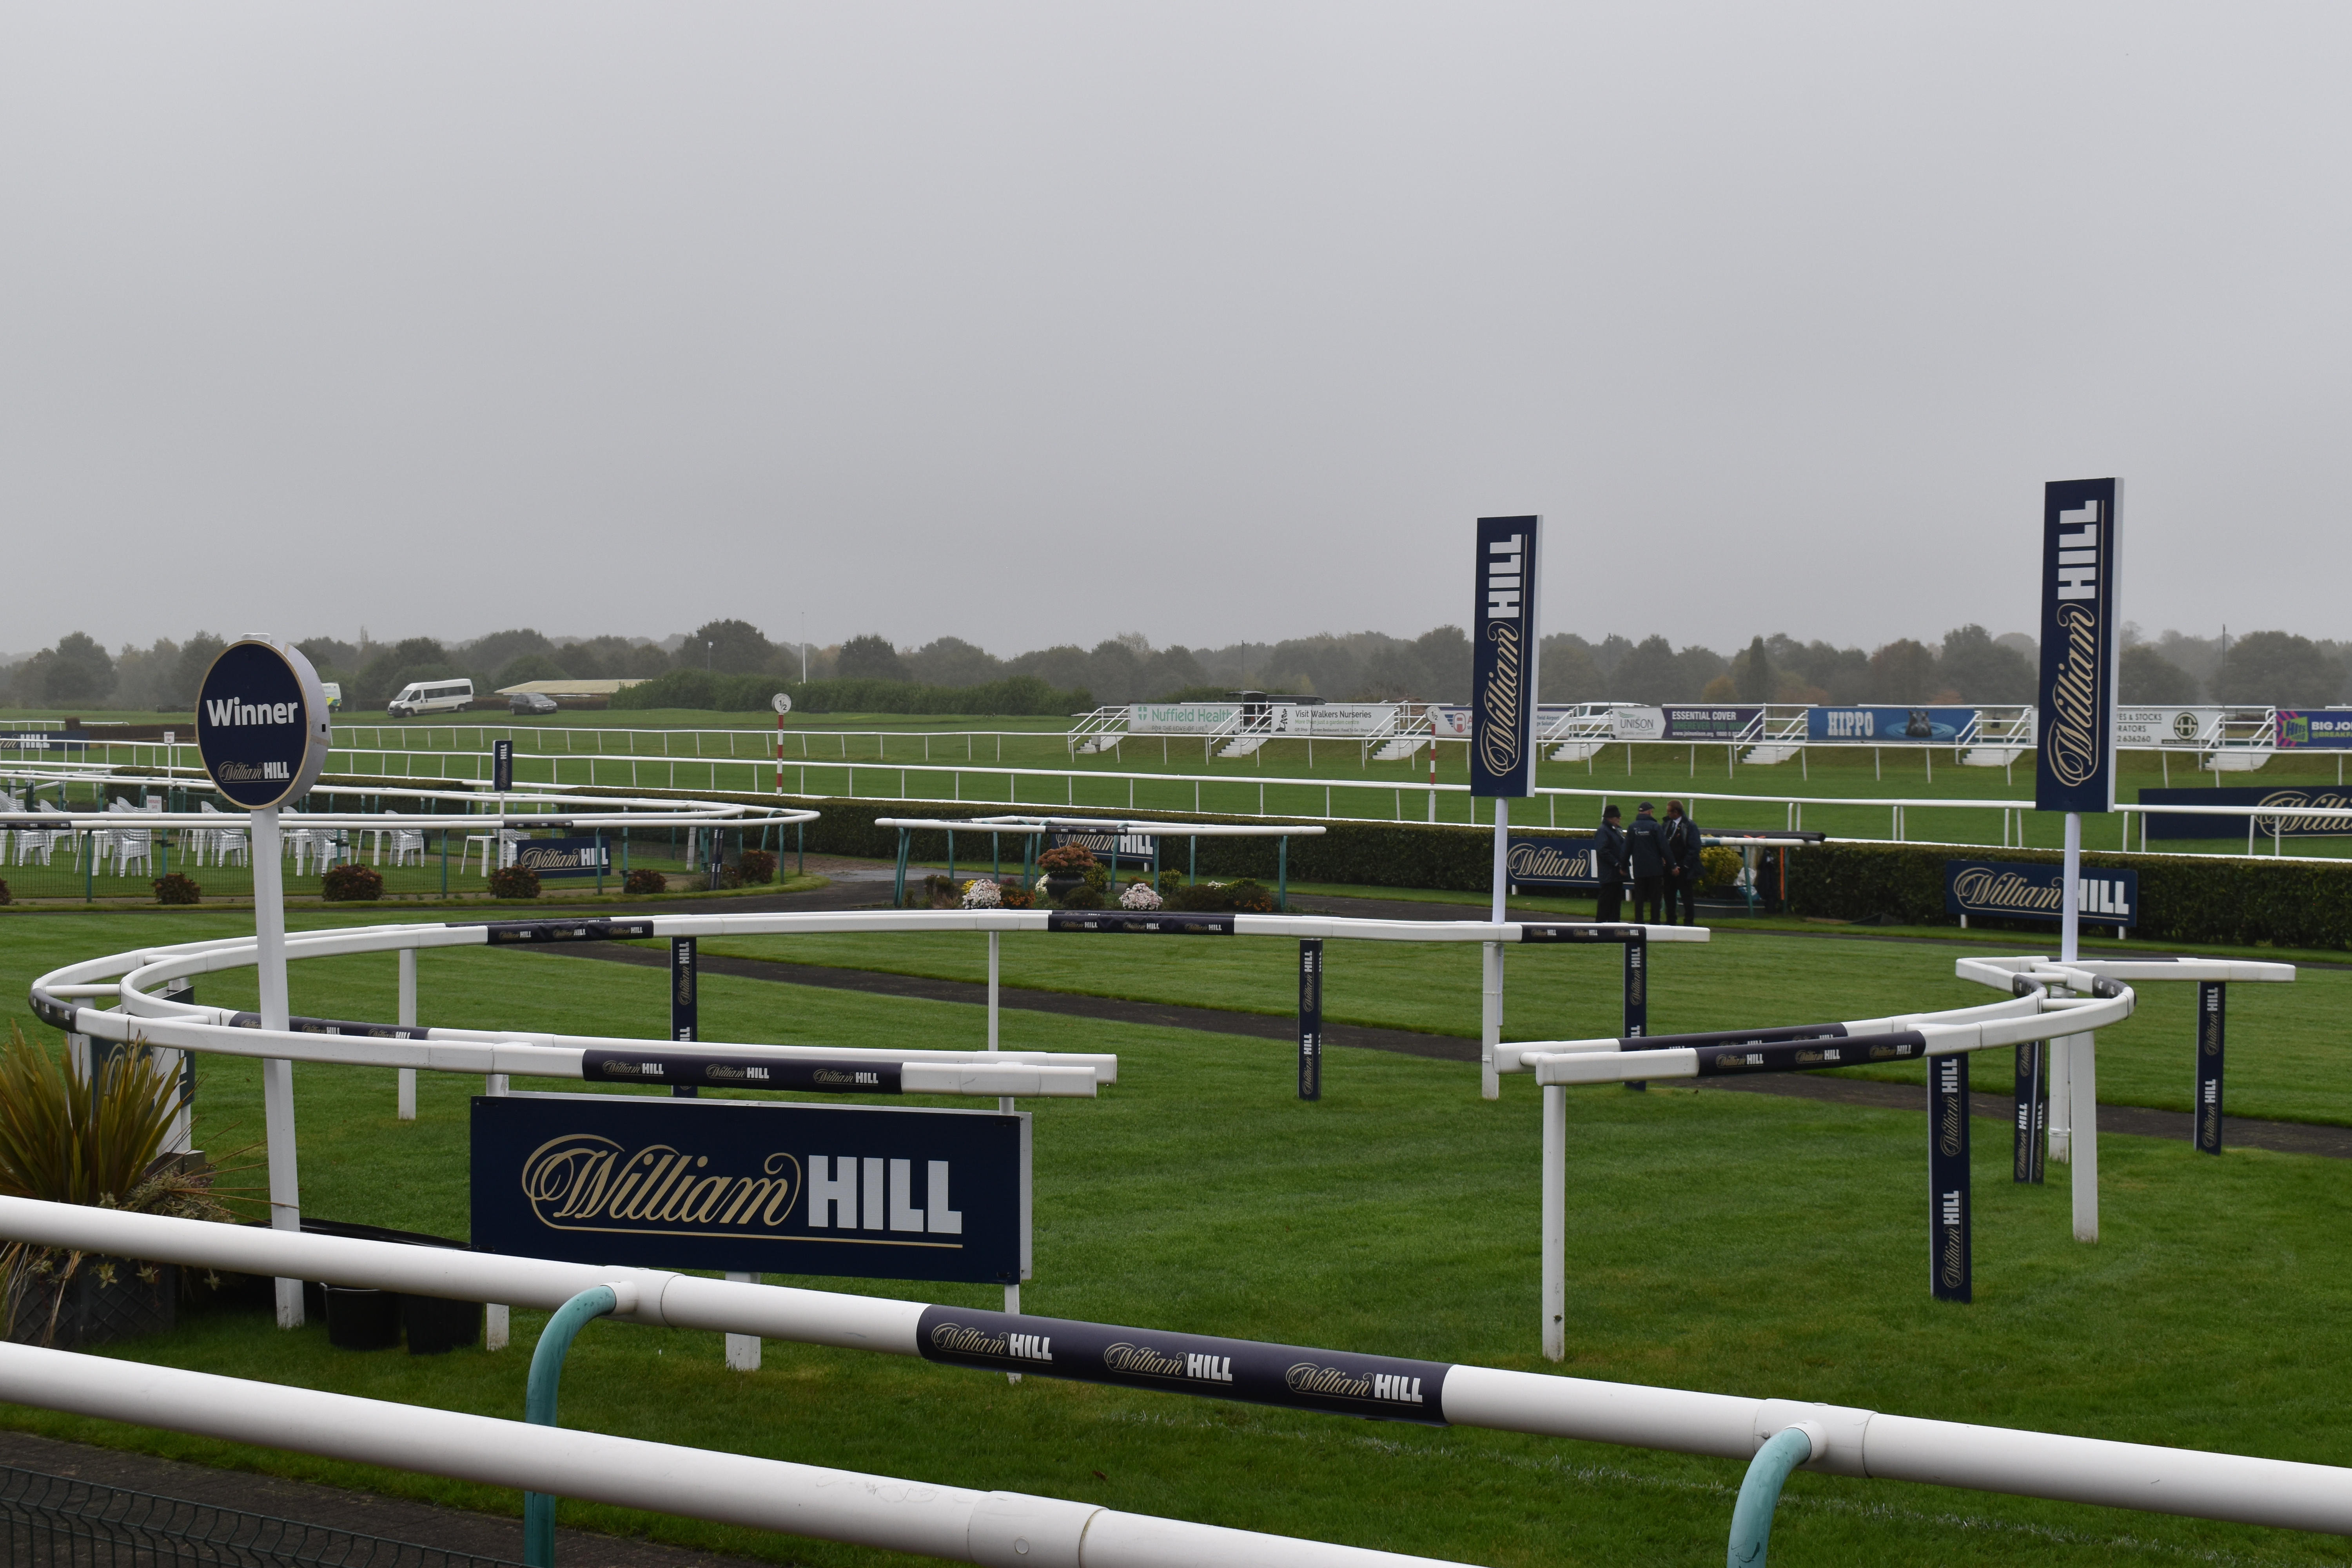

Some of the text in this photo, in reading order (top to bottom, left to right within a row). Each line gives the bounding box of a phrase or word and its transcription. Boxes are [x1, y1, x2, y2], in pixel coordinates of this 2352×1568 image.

[2048, 500, 2098, 786] William HILL
[1481, 534, 1522, 776] William HILL
[207, 697, 298, 726] Winner
[1152, 708, 1233, 722] Nuffield Health
[1672, 711, 1737, 720] ESSENTIAL COVER
[1621, 719, 1653, 728] UNISON
[1828, 711, 1873, 736] HIPPO
[2312, 722, 2333, 730] BIG
[218, 761, 289, 781] William HILL
[521, 848, 581, 868] William
[1506, 843, 1590, 878] William
[1953, 867, 2063, 909] William
[679, 942, 690, 964] HILL
[1304, 951, 1312, 972] HILL
[1631, 947, 1641, 967] HILL
[2207, 987, 2218, 1011] HILL
[680, 1027, 690, 1041] ILL
[1631, 1025, 1640, 1038] ILL
[1747, 1054, 1764, 1065] HILL
[1824, 1049, 1840, 1060] HILL
[1897, 1045, 1911, 1055] HILL
[603, 1060, 663, 1075] William HILL
[706, 1063, 769, 1079] William HILL
[813, 1069, 878, 1084] William HILL
[2204, 1079, 2216, 1103] HILL
[1940, 1058, 1958, 1156] William HILL
[2018, 1103, 2027, 1129] HILL
[522, 1134, 962, 1234] William HILL
[1942, 1191, 1960, 1288] William HILL
[932, 1323, 1052, 1361] William HILL
[1104, 1343, 1232, 1381] William HILL
[1286, 1363, 1423, 1403] William HILL
